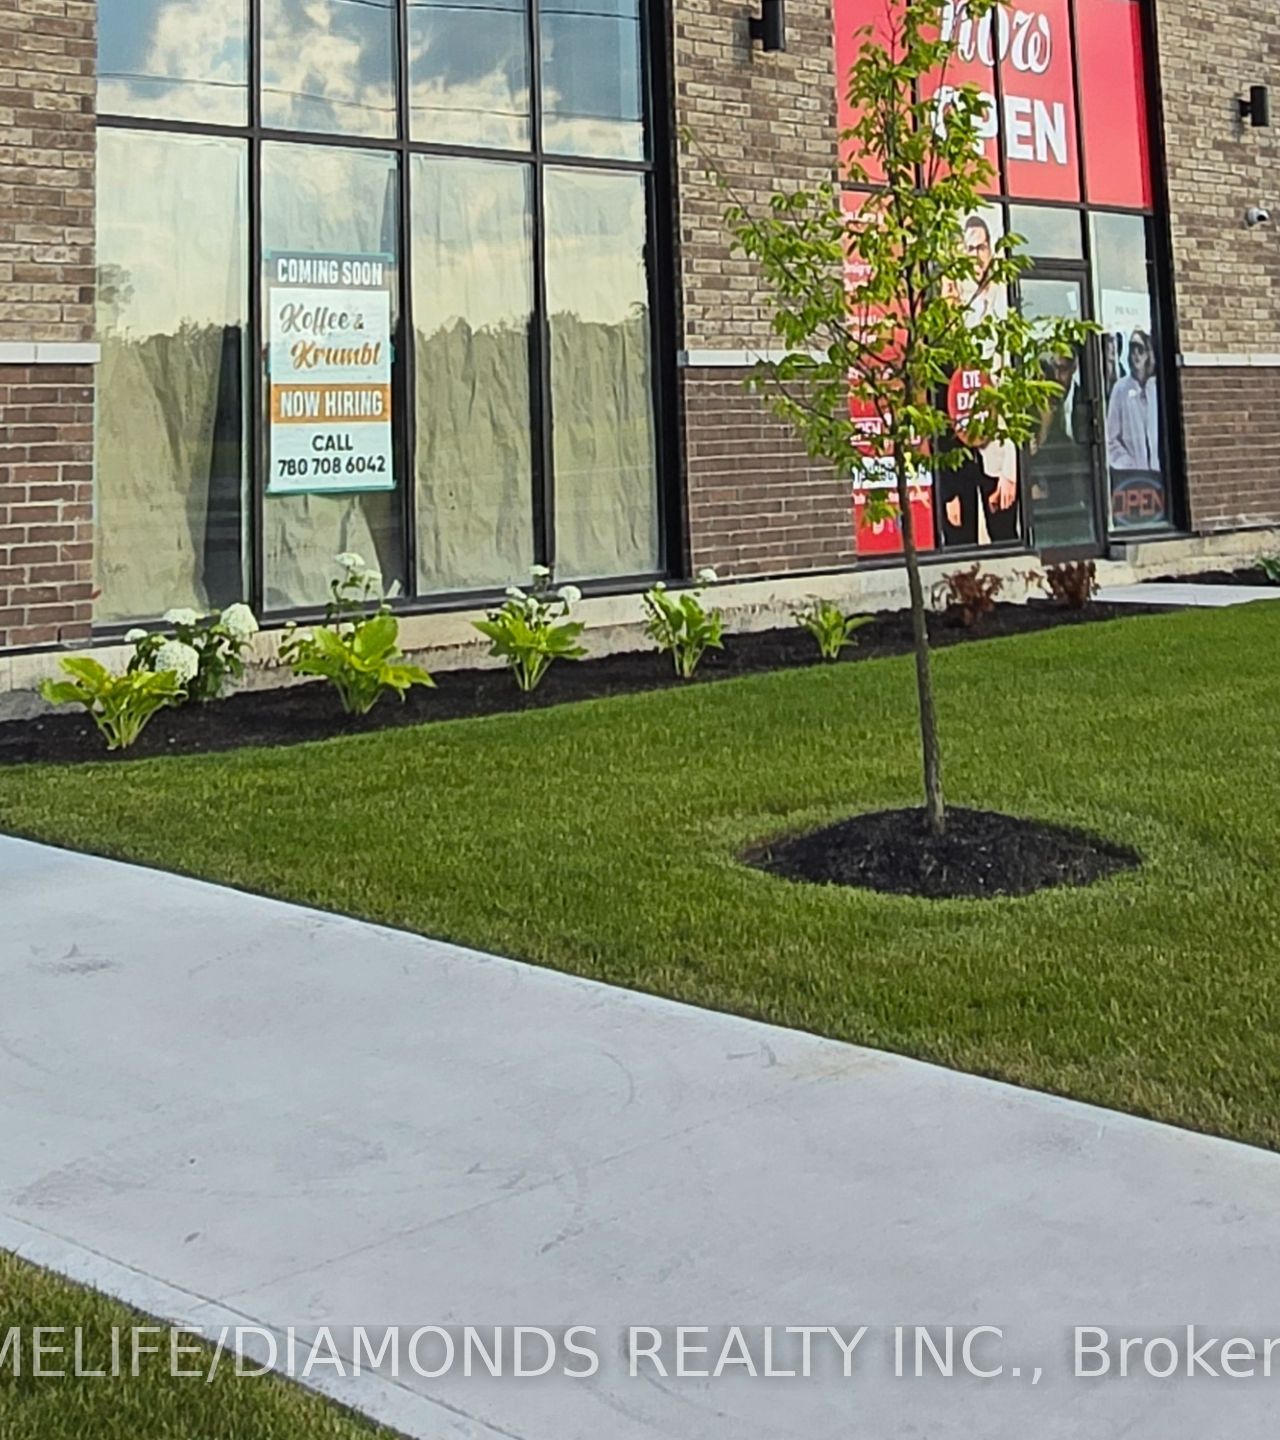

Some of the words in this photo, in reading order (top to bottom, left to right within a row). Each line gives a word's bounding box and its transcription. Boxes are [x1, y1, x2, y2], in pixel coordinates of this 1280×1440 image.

[277, 258, 339, 285] COMING
[342, 260, 383, 286] SOON
[279, 303, 351, 337] Koffee
[353, 313, 364, 330] &
[290, 340, 382, 371] Krumbl
[280, 390, 321, 418] NOW
[324, 390, 384, 417] HIRING
[311, 433, 354, 452] CALL
[277, 458, 308, 477] 780
[311, 456, 342, 475] 708
[345, 455, 386, 474] 6042
[1111, 488, 1165, 517] OPEN
